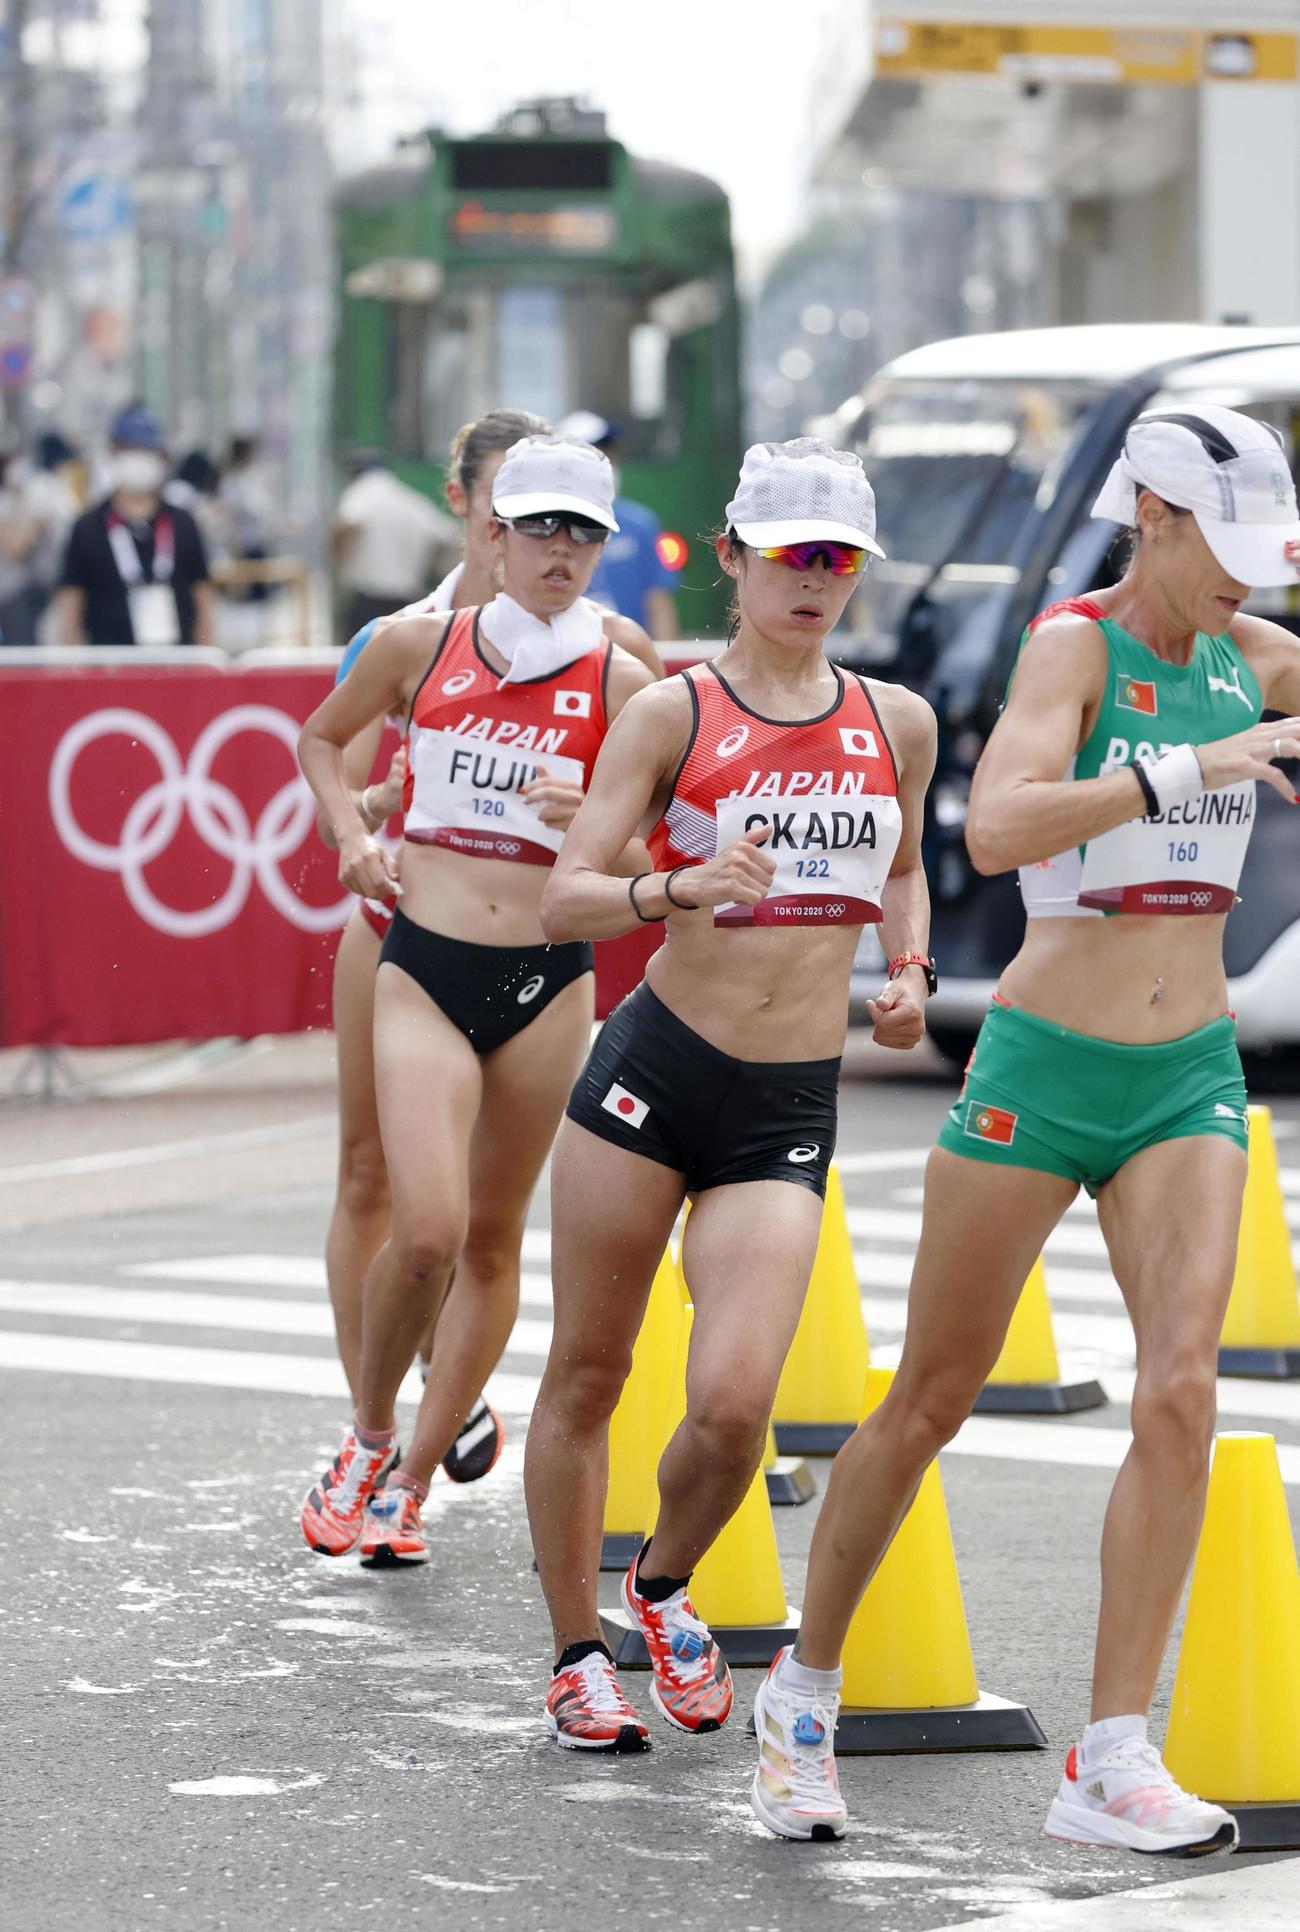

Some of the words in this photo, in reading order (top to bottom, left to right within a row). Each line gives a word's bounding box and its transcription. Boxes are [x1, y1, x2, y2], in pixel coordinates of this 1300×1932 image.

[443, 712, 569, 755] JAPAN
[728, 770, 866, 799] JAPAN
[472, 798, 505, 817] 120
[744, 810, 877, 850] OKADA
[449, 834, 474, 848] TOKYO
[474, 838, 494, 850] 2020
[1167, 841, 1199, 863] 160
[795, 858, 830, 878] 122
[1142, 893, 1169, 904] TOKYO
[1169, 893, 1189, 904] 2020
[773, 905, 803, 916] TOKYO
[803, 905, 823, 916] 2020
